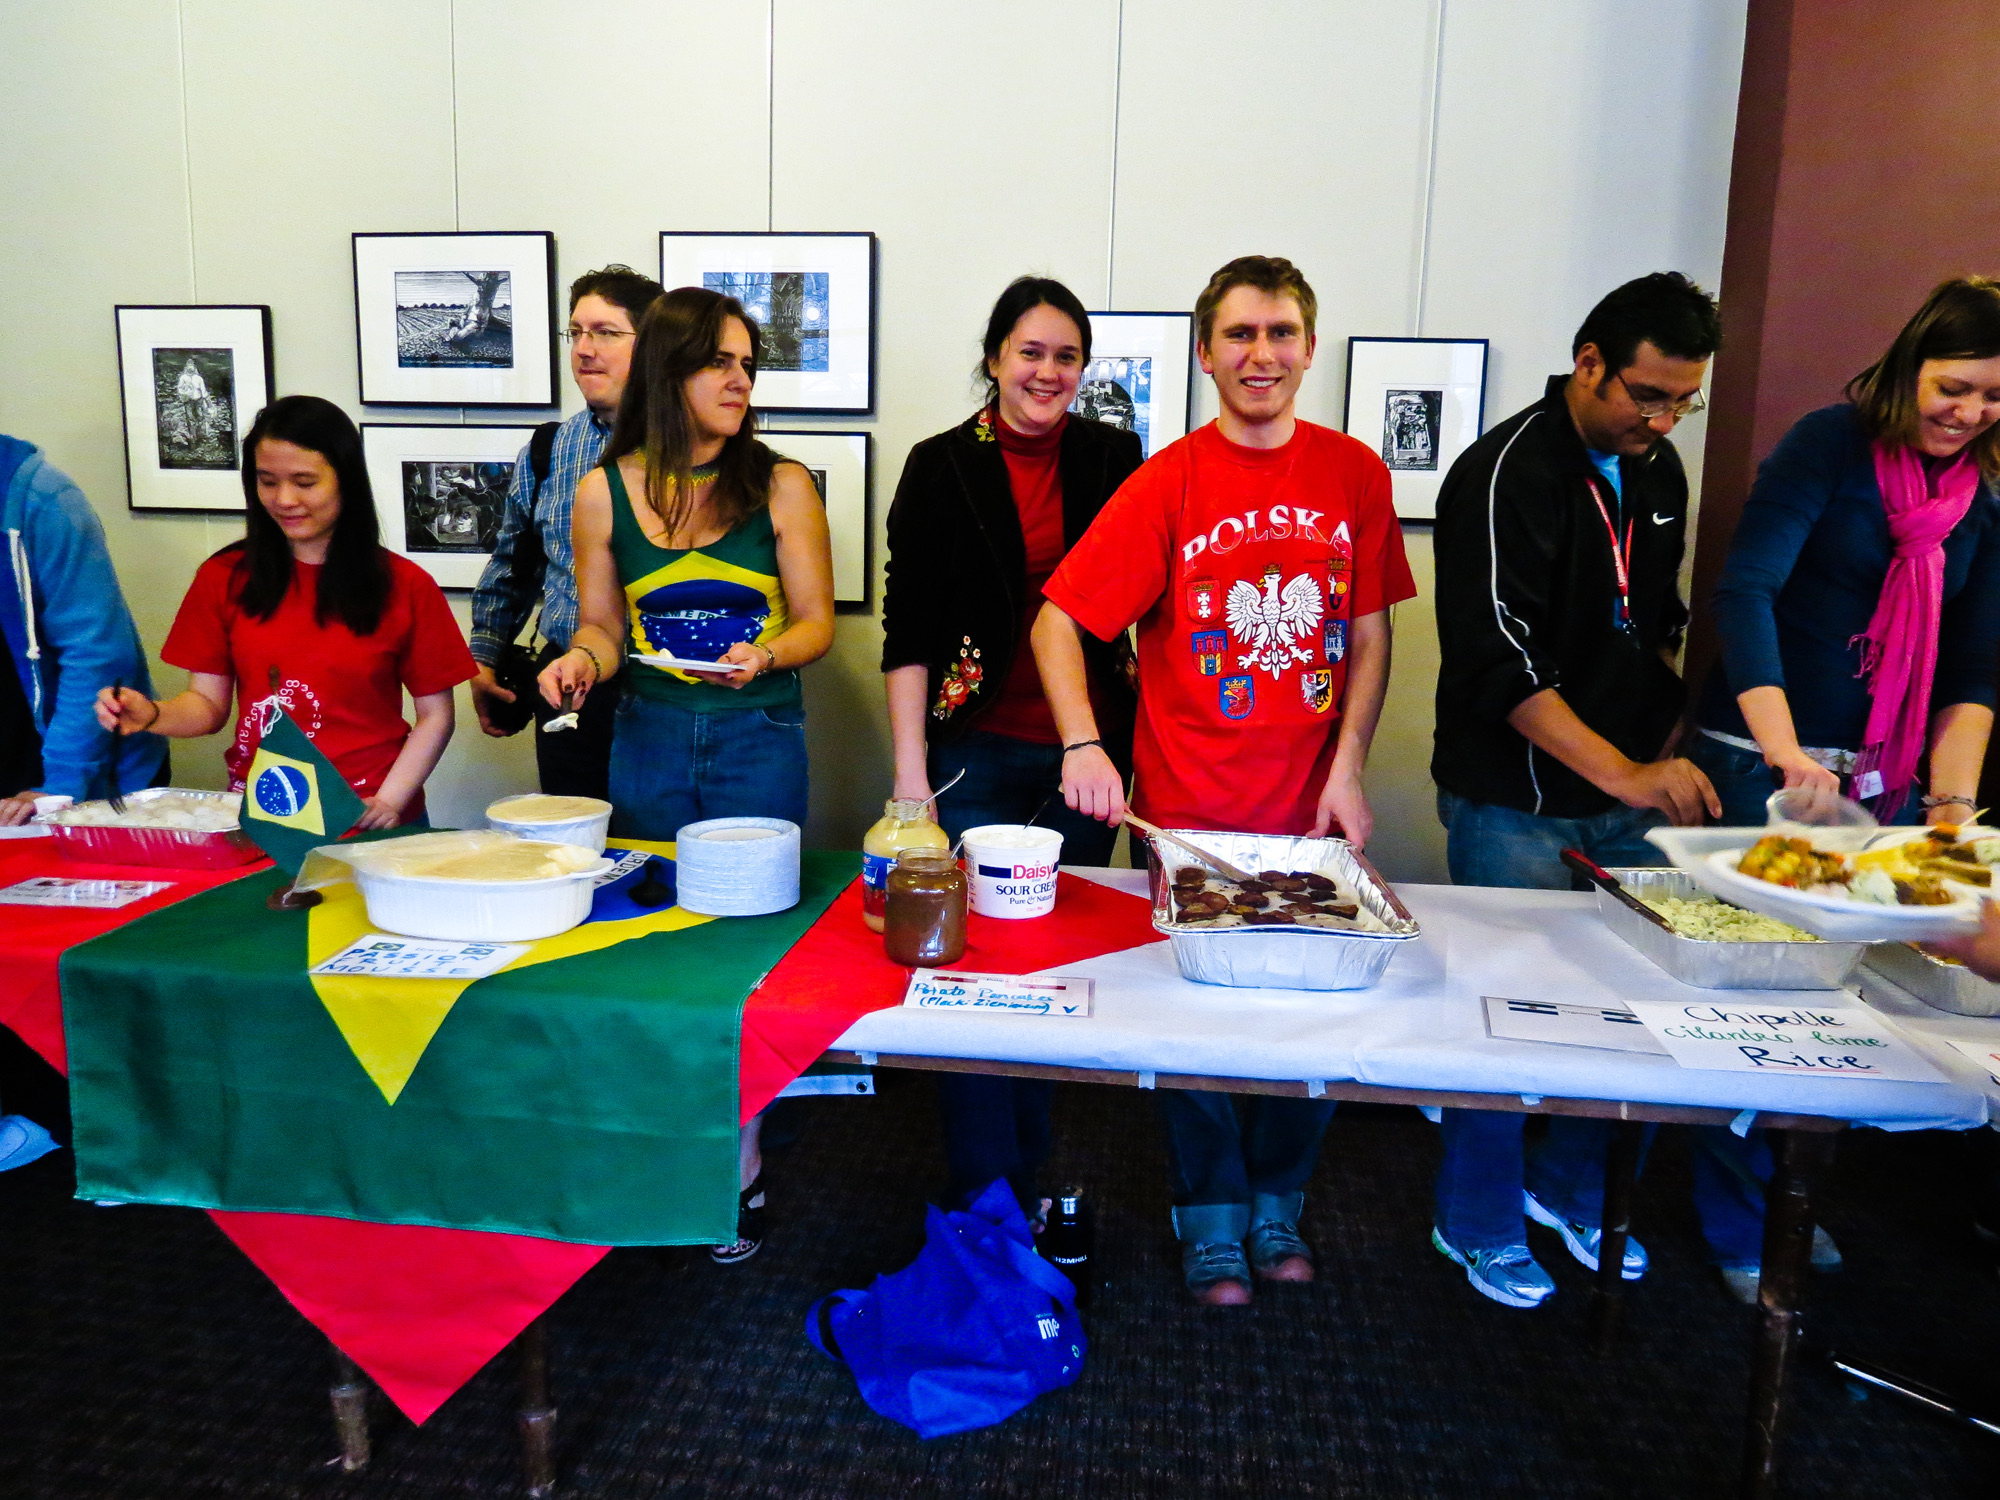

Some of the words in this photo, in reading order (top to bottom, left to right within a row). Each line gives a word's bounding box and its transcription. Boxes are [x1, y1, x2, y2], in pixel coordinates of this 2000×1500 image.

[1182, 505, 1352, 577] POLSKA
[599, 853, 649, 880] ORDEM
[1013, 864, 1053, 880] Daisy
[996, 885, 1030, 895] SOUR
[1009, 897, 1026, 905] Pure
[343, 948, 491, 962] PASSION
[319, 963, 473, 975] MOUSSE
[334, 957, 456, 969] FRUIT
[913, 982, 966, 996] Potato
[1684, 1006, 1845, 1030] Chipotle
[1738, 1046, 1876, 1069] Rice
